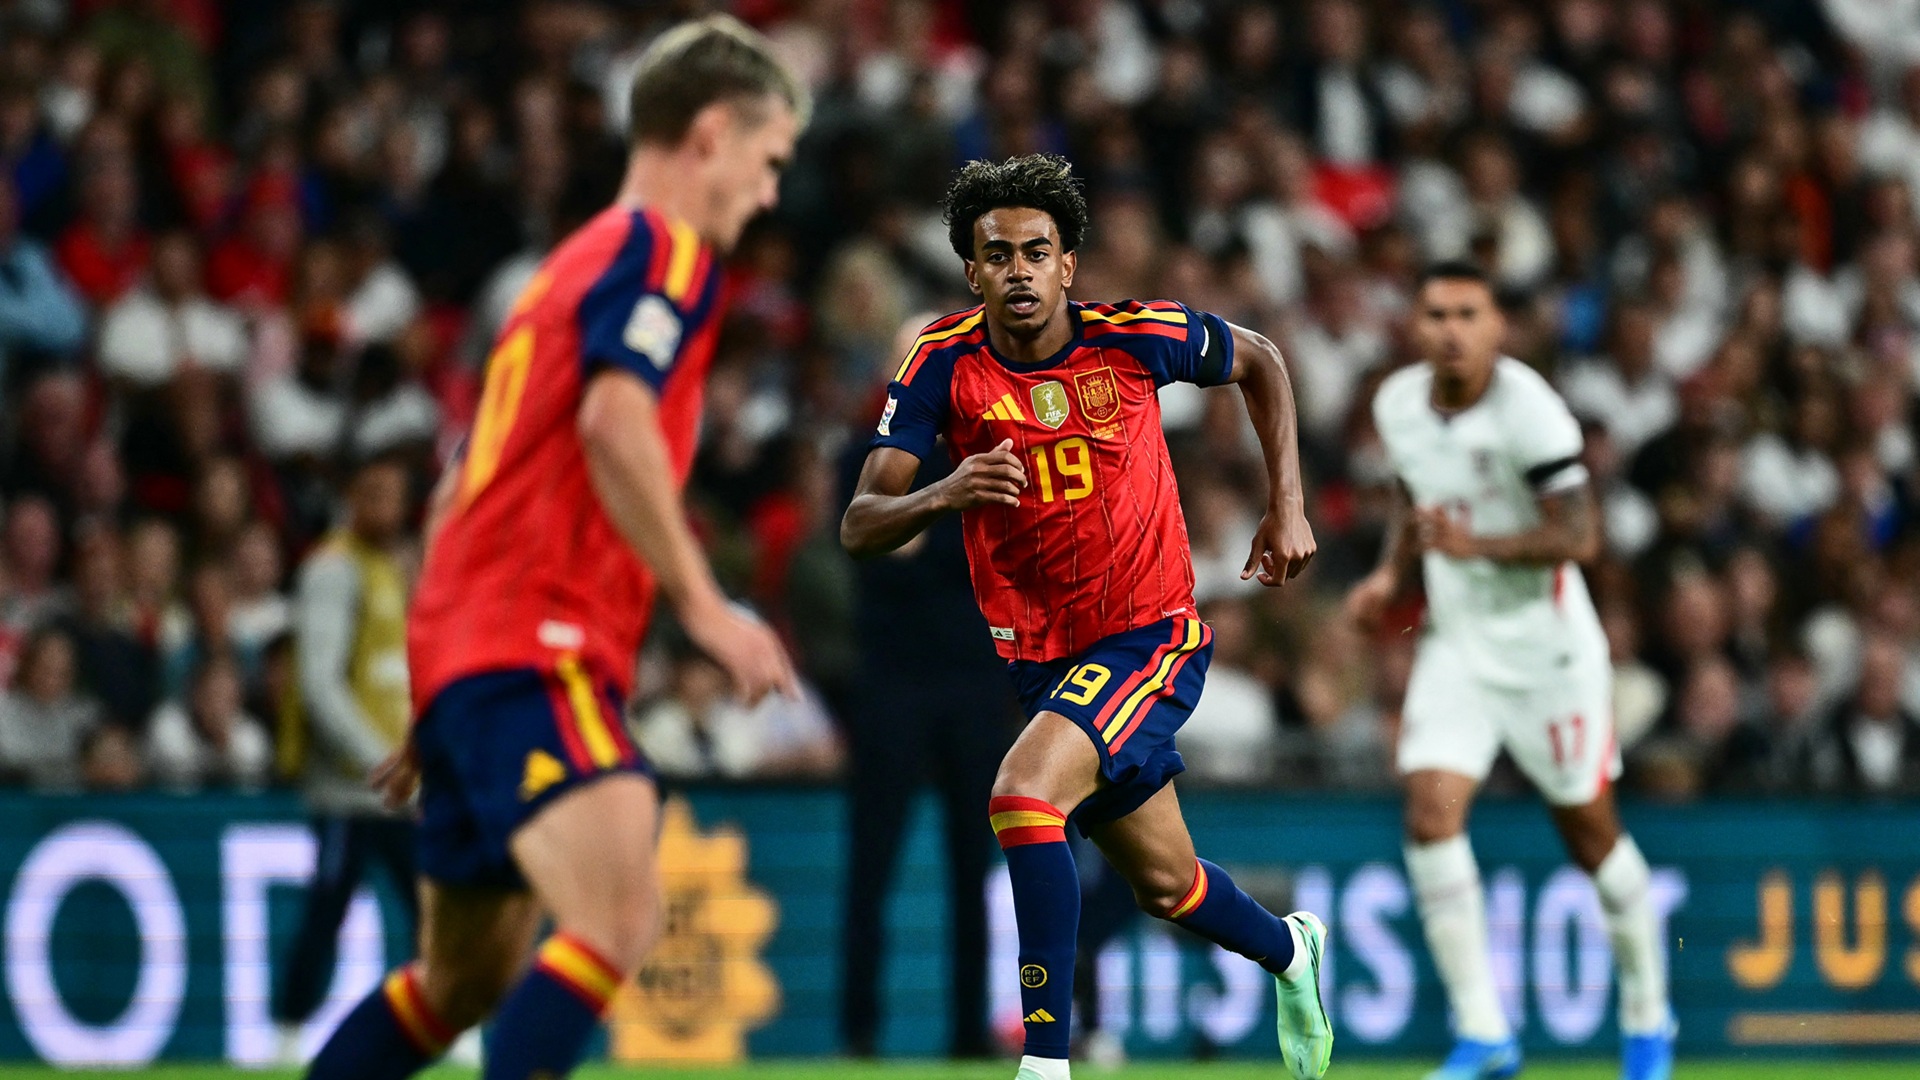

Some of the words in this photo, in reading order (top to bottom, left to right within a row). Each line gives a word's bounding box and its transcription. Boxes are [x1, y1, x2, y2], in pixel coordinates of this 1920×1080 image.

[1045, 410, 1061, 419] FIFA
[1031, 437, 1094, 503] 19
[1727, 867, 1920, 988] JU
